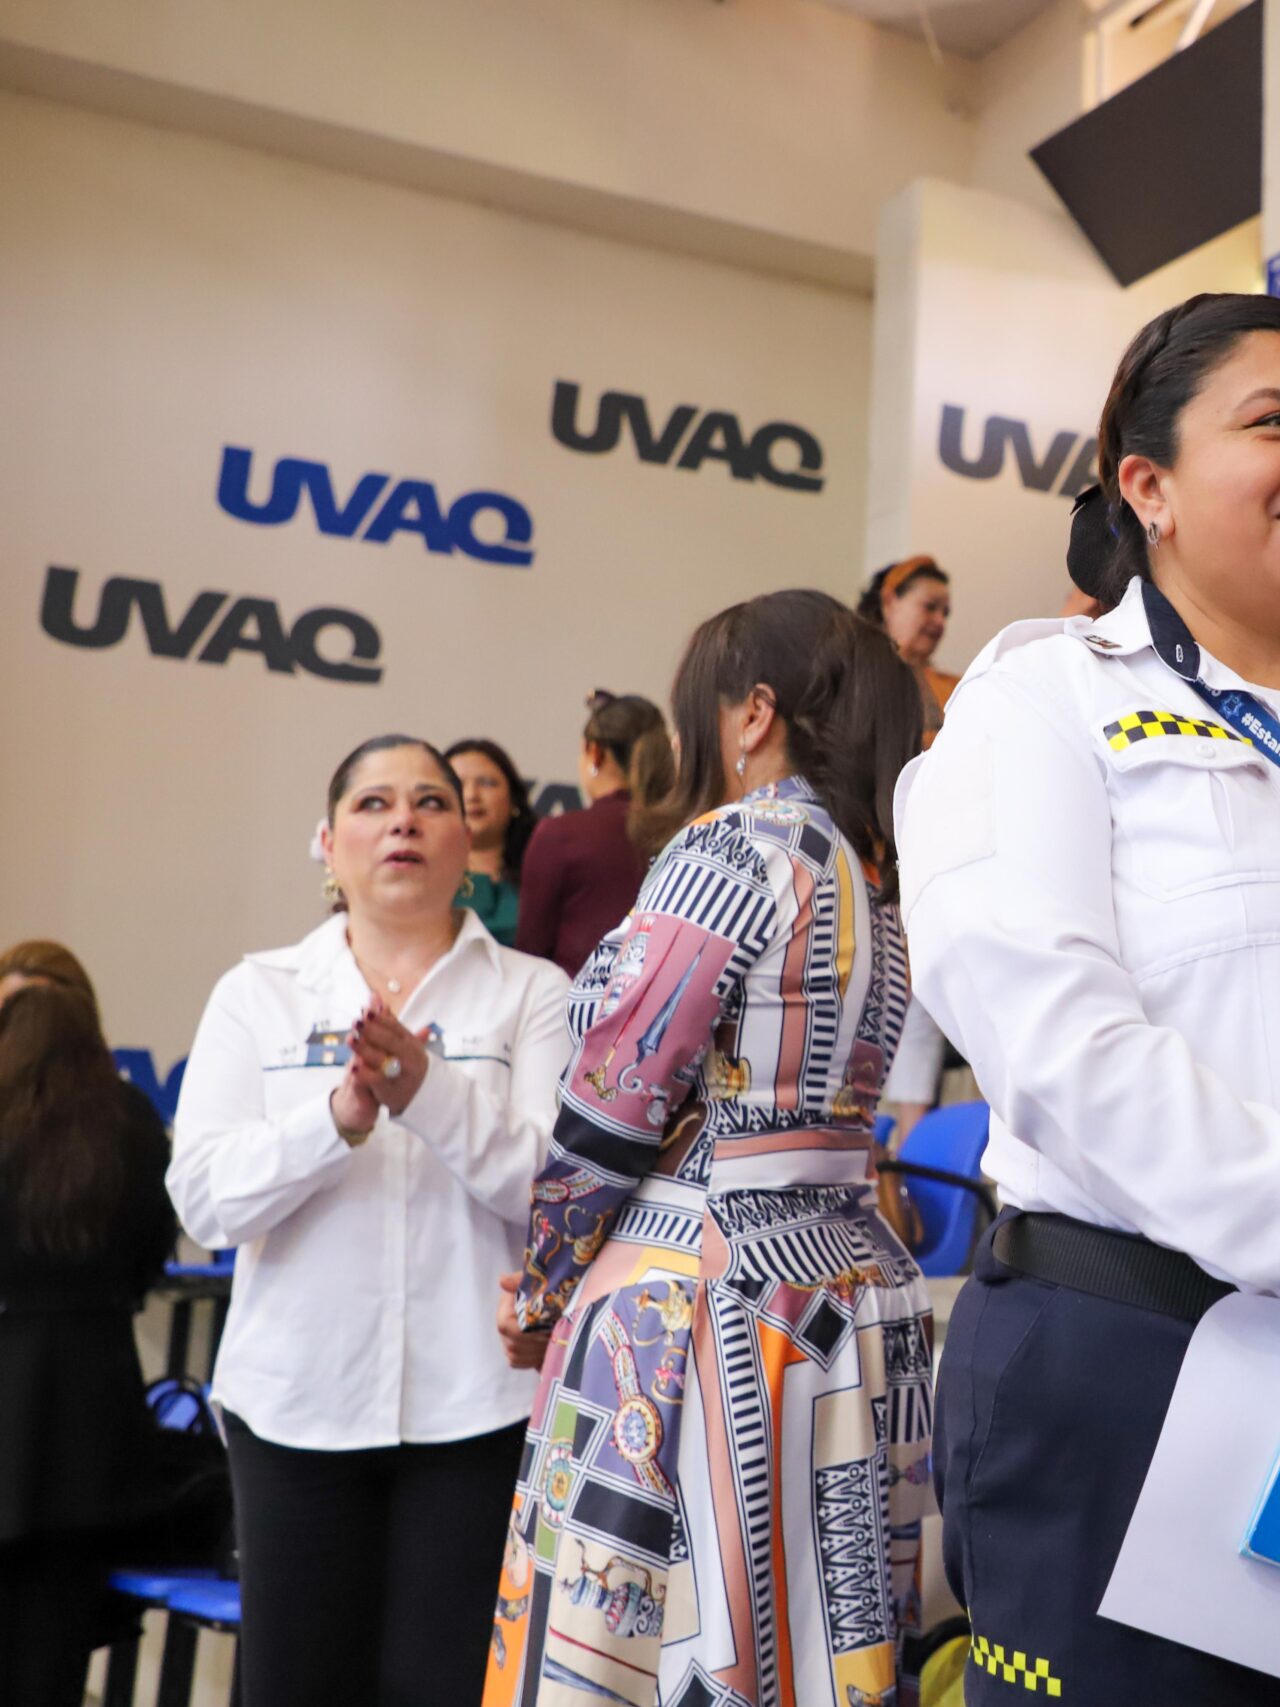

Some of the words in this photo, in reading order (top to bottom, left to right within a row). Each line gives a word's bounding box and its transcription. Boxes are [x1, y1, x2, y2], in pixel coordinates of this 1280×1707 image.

[550, 379, 826, 494] UVAQ
[940, 404, 1102, 498] UVA
[216, 445, 535, 567] UVAQ
[38, 564, 384, 685] UVAQ
